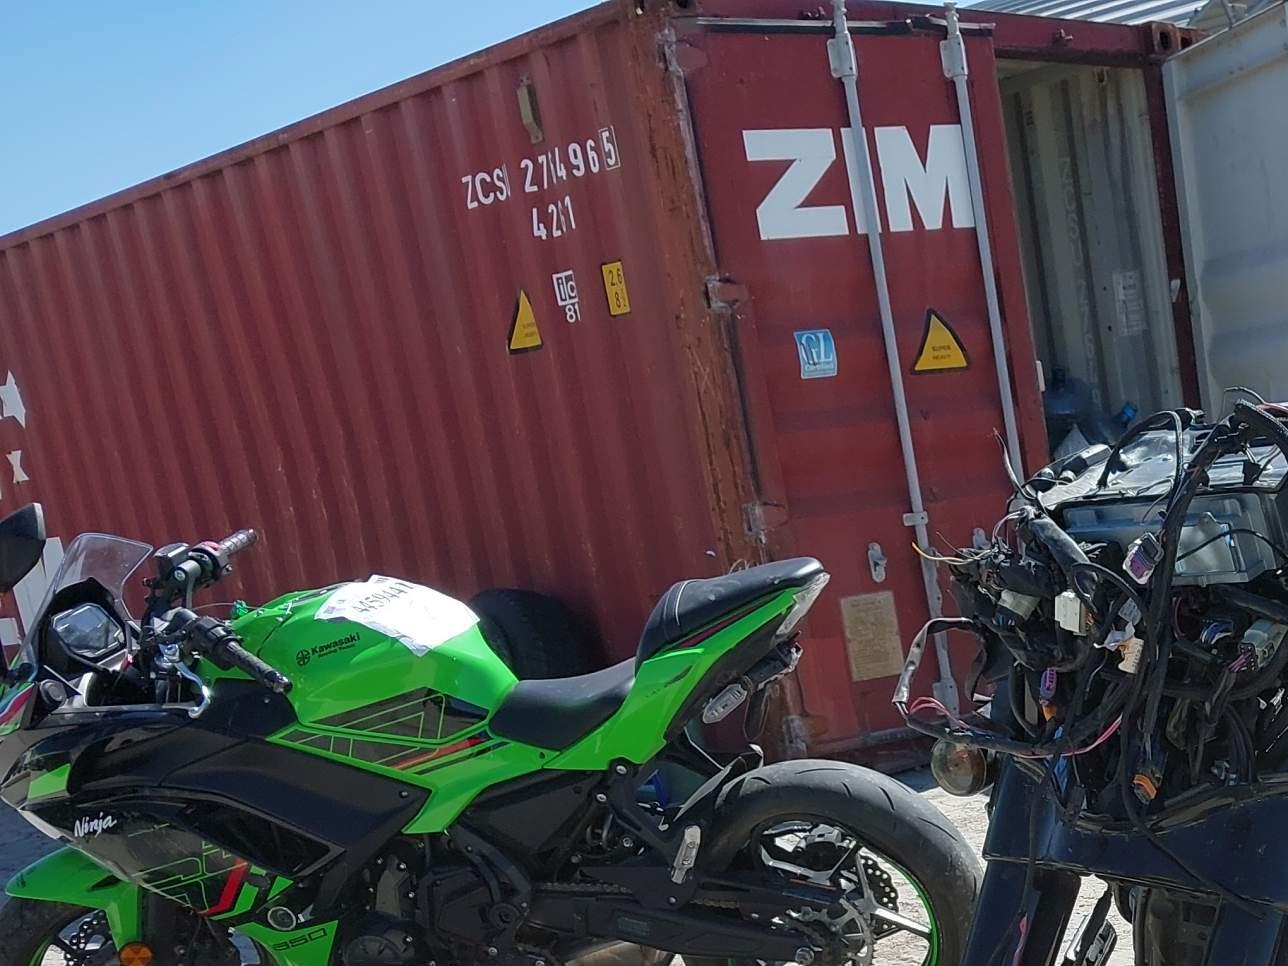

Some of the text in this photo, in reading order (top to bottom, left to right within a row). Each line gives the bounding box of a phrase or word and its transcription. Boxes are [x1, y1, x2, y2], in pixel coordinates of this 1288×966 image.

[461, 163, 511, 209] ZCS
[742, 124, 977, 240] ZIM
[565, 302, 581, 323] 81
[311, 632, 361, 656] Kawasaki
[74, 812, 117, 838] Ninja
